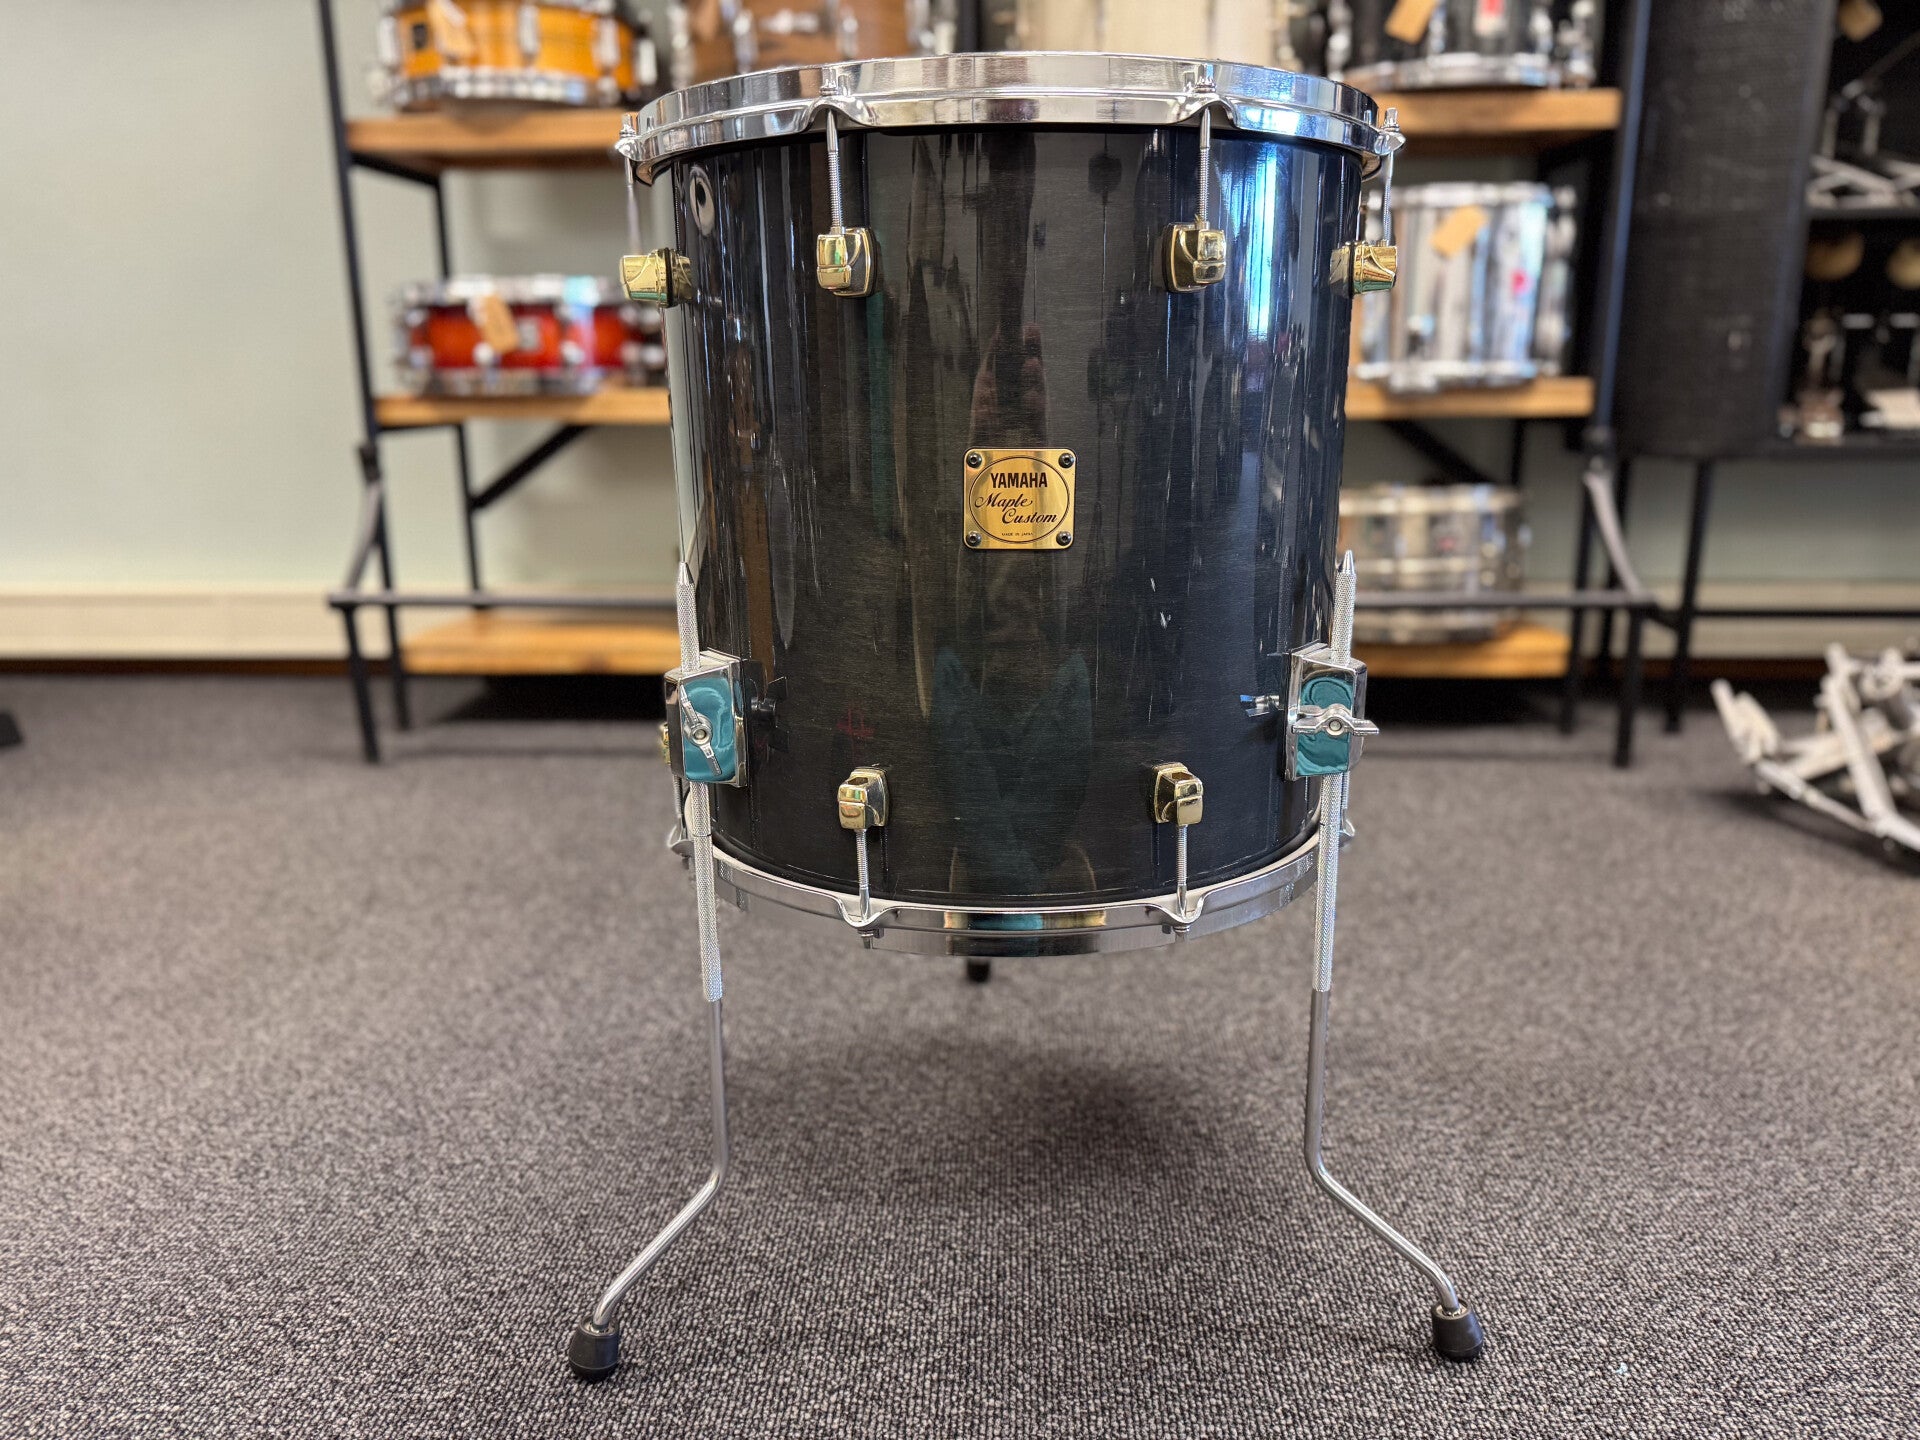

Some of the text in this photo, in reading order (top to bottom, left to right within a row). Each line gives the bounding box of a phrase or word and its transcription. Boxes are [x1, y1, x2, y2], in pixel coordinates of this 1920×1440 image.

[990, 472, 1048, 488] YAMAHA
[974, 492, 1033, 512] Maple
[1002, 508, 1057, 524] Custom
